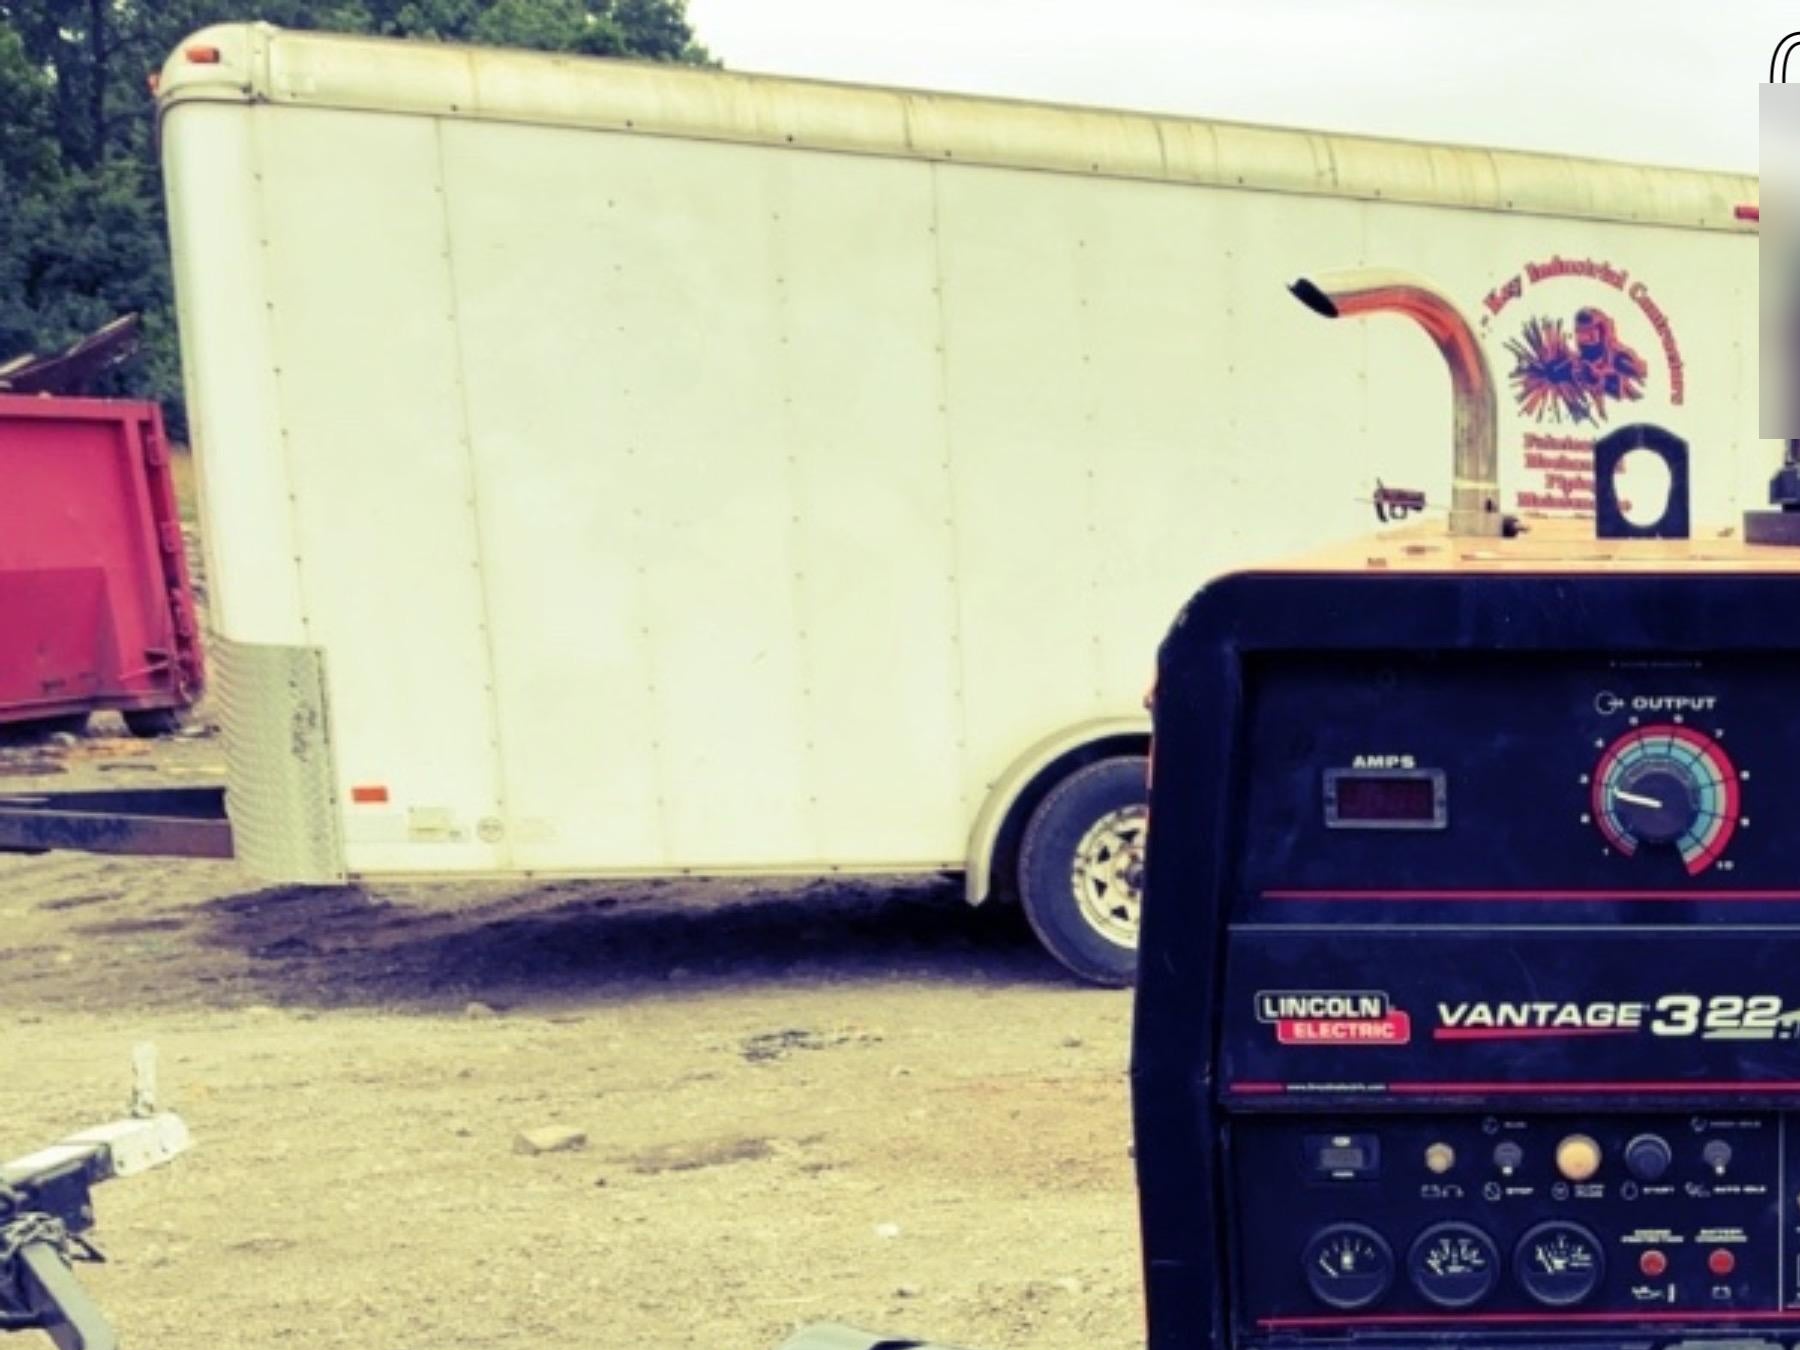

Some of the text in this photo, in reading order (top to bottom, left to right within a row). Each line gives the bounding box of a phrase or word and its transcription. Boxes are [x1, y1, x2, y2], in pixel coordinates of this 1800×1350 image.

[1631, 696, 1717, 710] OUTPUT
[1352, 755, 1415, 769] AMPS
[1263, 998, 1382, 1018] LINCOLN
[1438, 1002, 1643, 1027] VANTAGE
[1651, 994, 1782, 1036] 322
[1293, 1023, 1395, 1039] ELECTRIC
